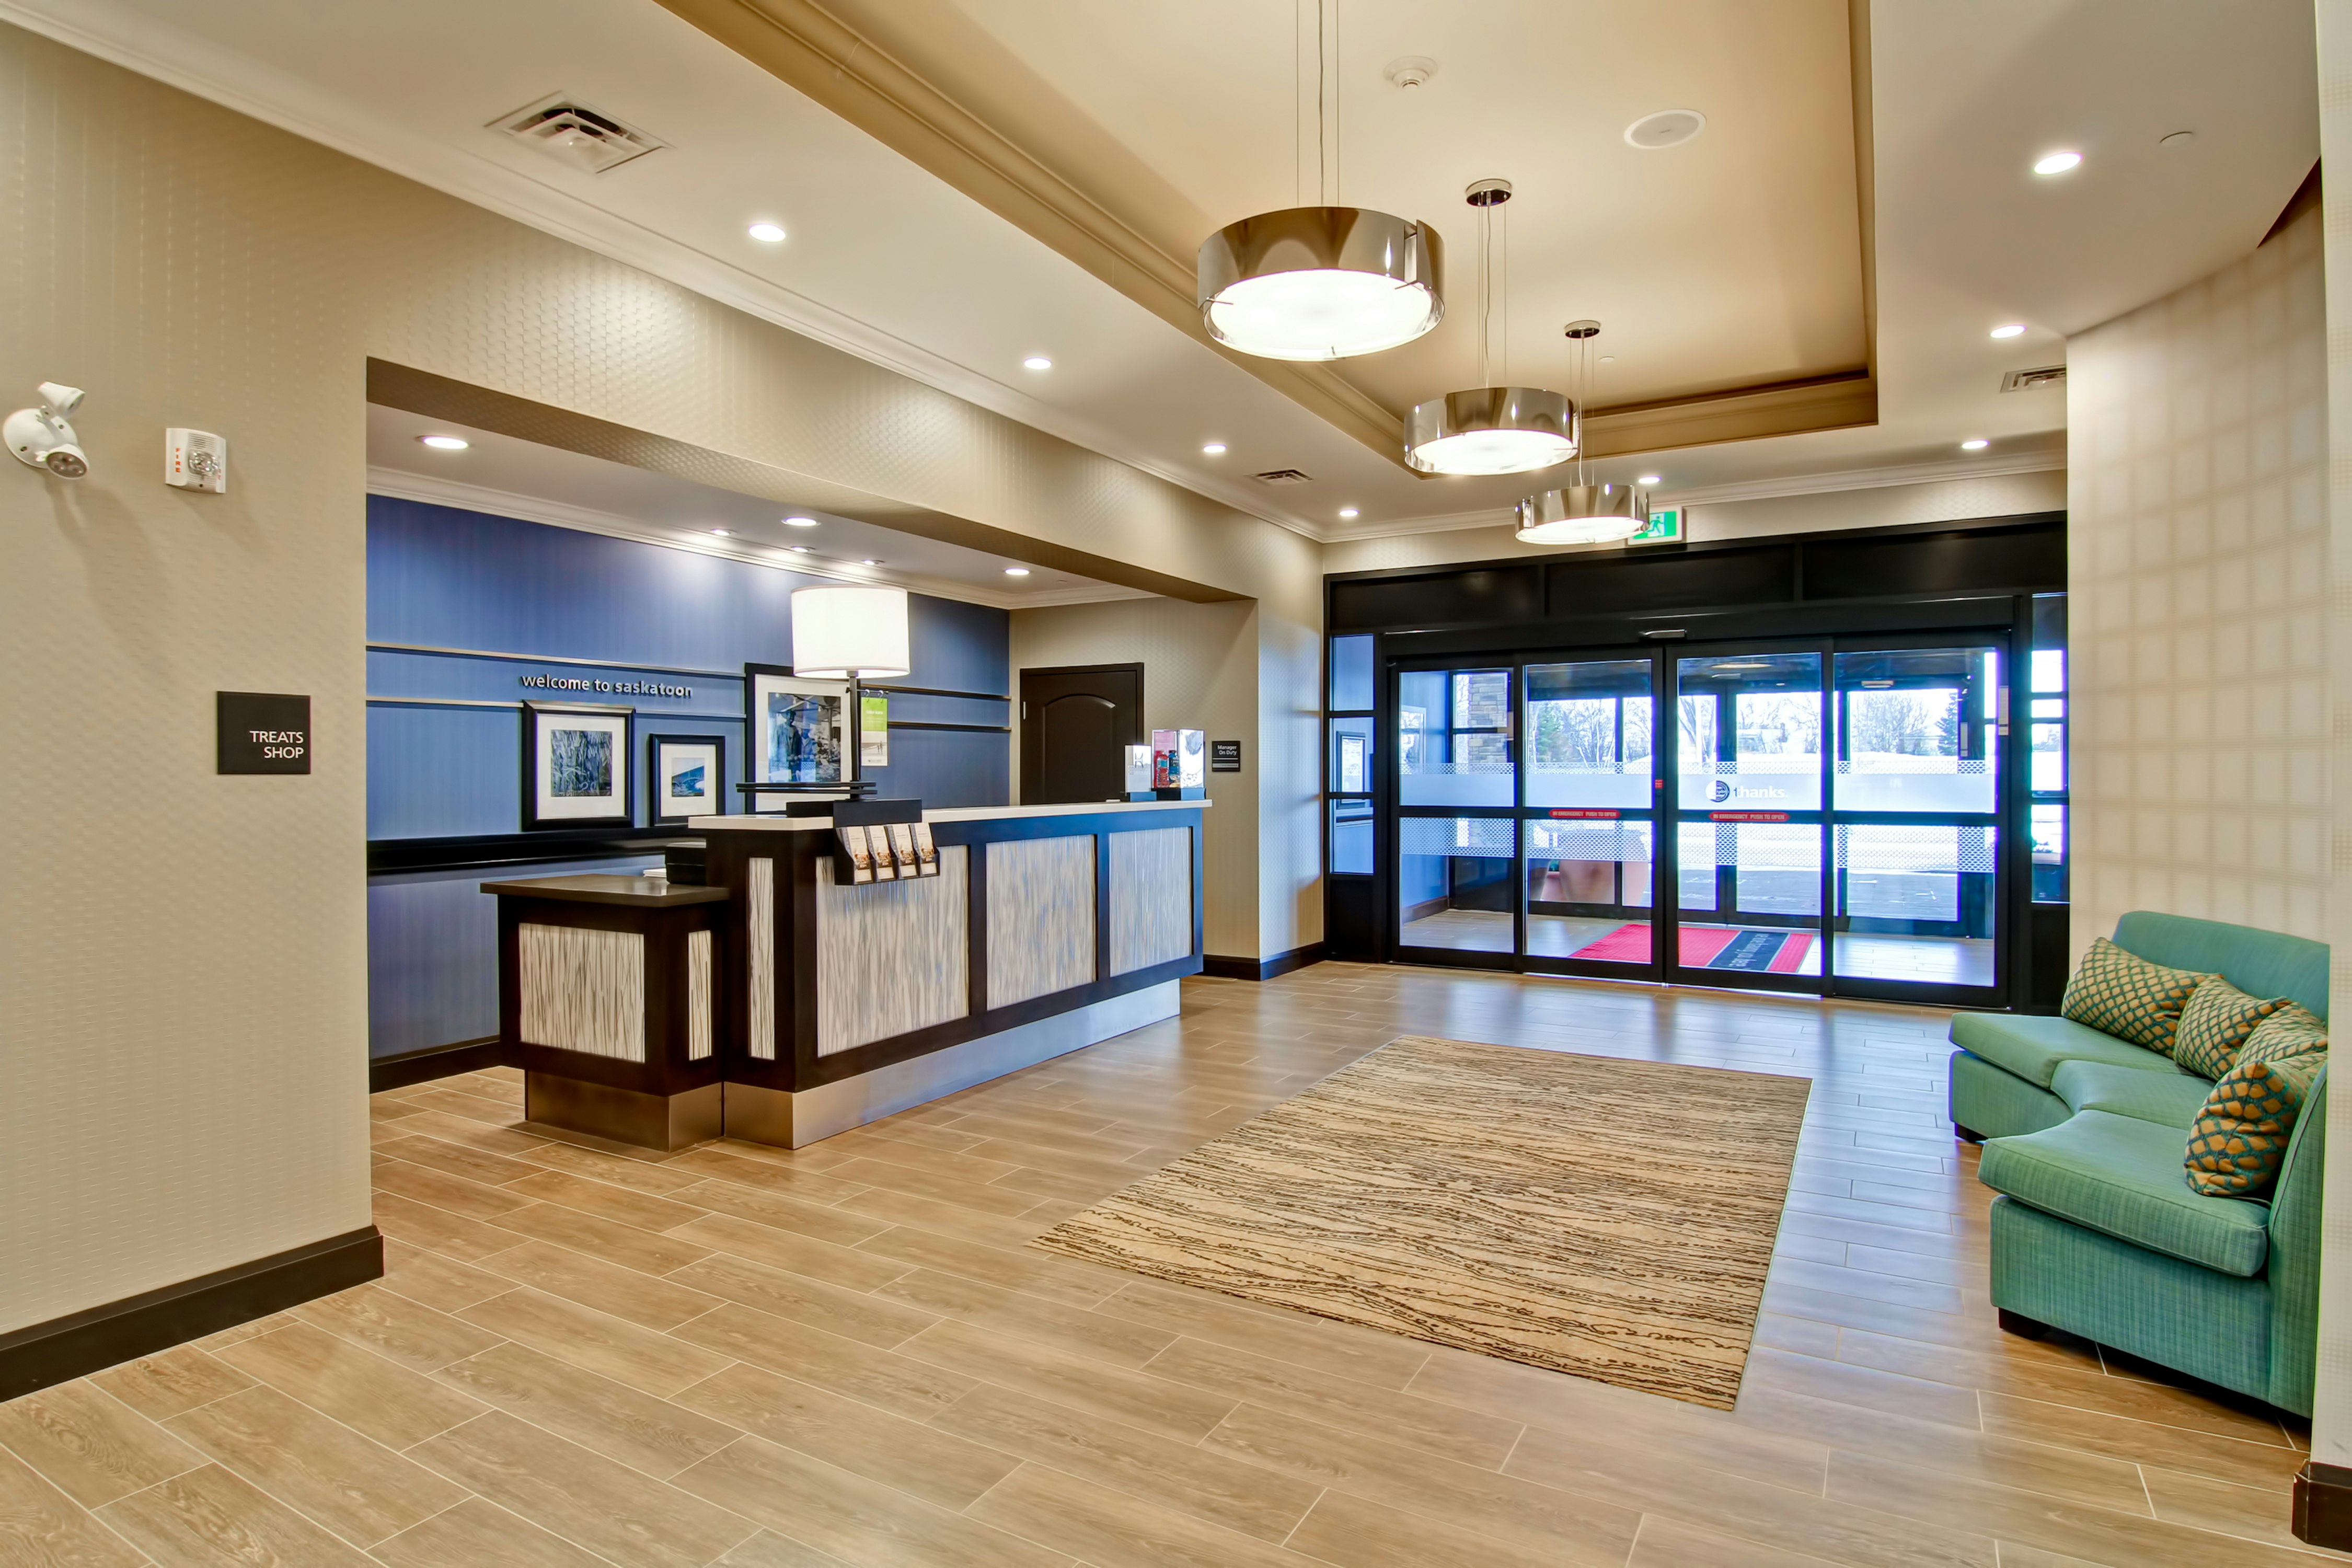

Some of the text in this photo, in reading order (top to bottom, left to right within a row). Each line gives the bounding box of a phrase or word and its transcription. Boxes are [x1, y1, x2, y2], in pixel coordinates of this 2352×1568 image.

[522, 674, 693, 697] welcome to saskatoon
[249, 730, 304, 744] TREATS
[263, 746, 304, 759] SHOP
[1733, 786, 1788, 798] thanks.
